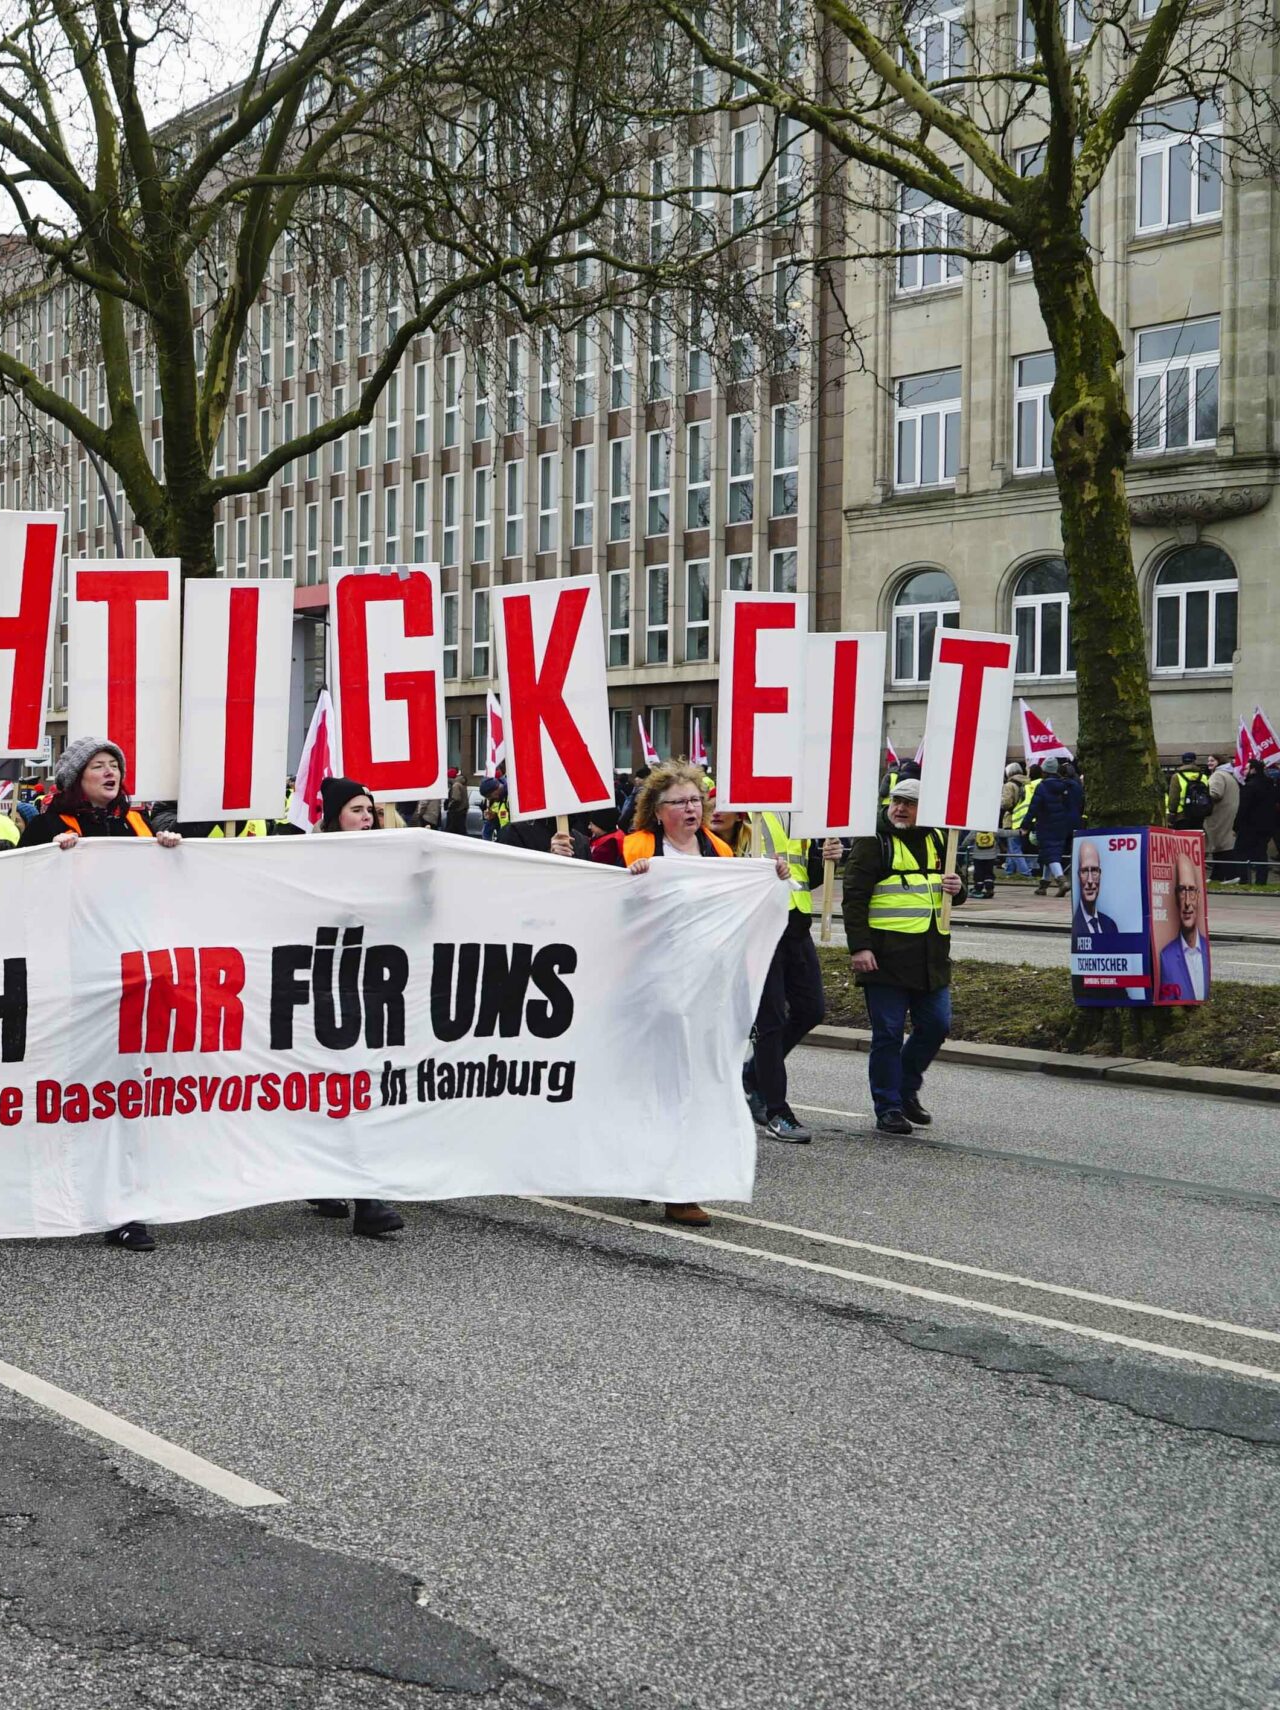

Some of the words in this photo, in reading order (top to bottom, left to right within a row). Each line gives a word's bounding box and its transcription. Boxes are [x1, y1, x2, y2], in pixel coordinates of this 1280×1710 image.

[1108, 838, 1137, 851] SPD
[1077, 937, 1092, 950] PETER
[1077, 958, 1128, 971] TSCHENTSCHER
[118, 947, 246, 1054] IHR
[269, 925, 409, 1050] FÜR
[430, 943, 578, 1042] UNS
[35, 1067, 372, 1124] Daseinsvorsorge
[380, 1060, 408, 1106] in
[417, 1054, 576, 1103] Hamburg
